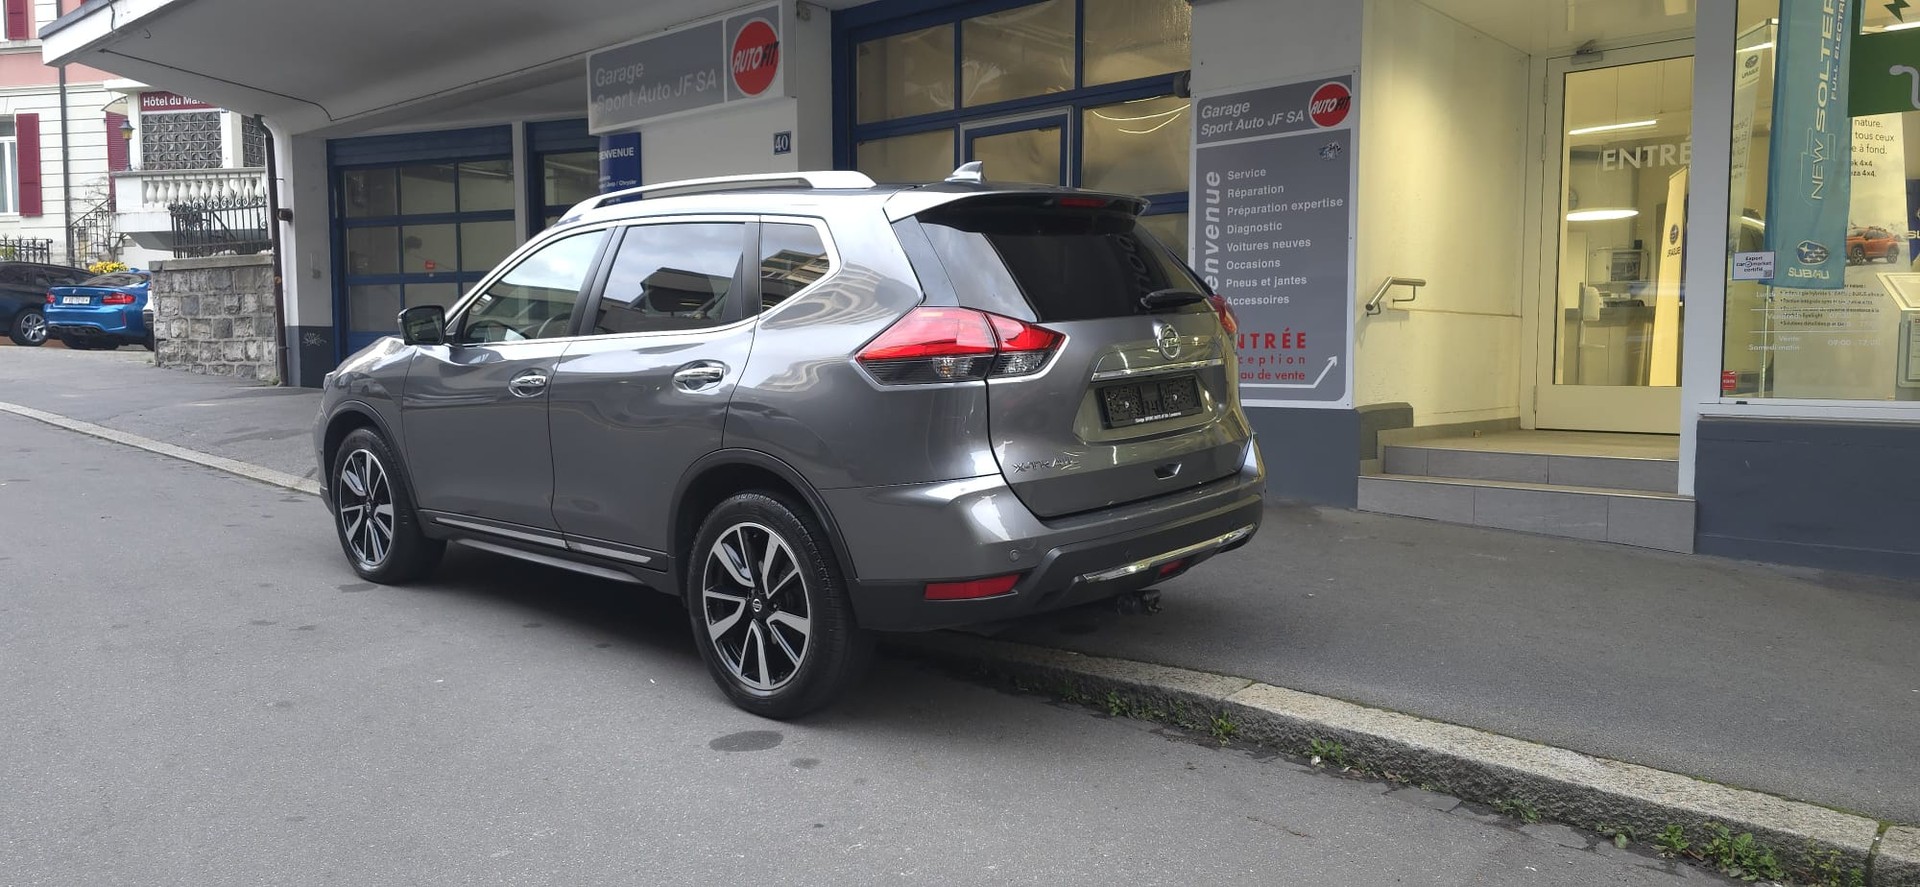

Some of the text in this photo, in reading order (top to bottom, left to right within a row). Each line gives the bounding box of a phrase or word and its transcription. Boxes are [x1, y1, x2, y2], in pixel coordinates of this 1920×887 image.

[732, 41, 780, 73] AUTOFIT
[595, 62, 644, 87] Garage
[1830, 64, 1839, 100] FULL
[597, 68, 717, 117] Sport Auto JF SA
[143, 96, 168, 107] Hôtel
[170, 96, 181, 105] du
[1310, 95, 1352, 116] AUTOFIT
[1200, 101, 1250, 120] Garage
[1200, 109, 1305, 137] Sport Auto JF SA
[776, 135, 789, 151] 40
[1855, 131, 1895, 142] tous ceux
[1866, 143, 1888, 154] fond.
[1227, 168, 1267, 180] Service
[1811, 138, 1825, 200] NEW
[1227, 184, 1285, 200] Réparation
[1227, 197, 1344, 218] Préparation expertise
[1227, 221, 1283, 235] Diagnostic
[1226, 238, 1311, 252] Voitures neuves
[1226, 259, 1281, 270] Occasions
[1226, 276, 1308, 288] Pneus et jantes
[1227, 294, 1290, 306] Accessoires
[1257, 368, 1272, 380] de
[1275, 370, 1306, 380] vente
